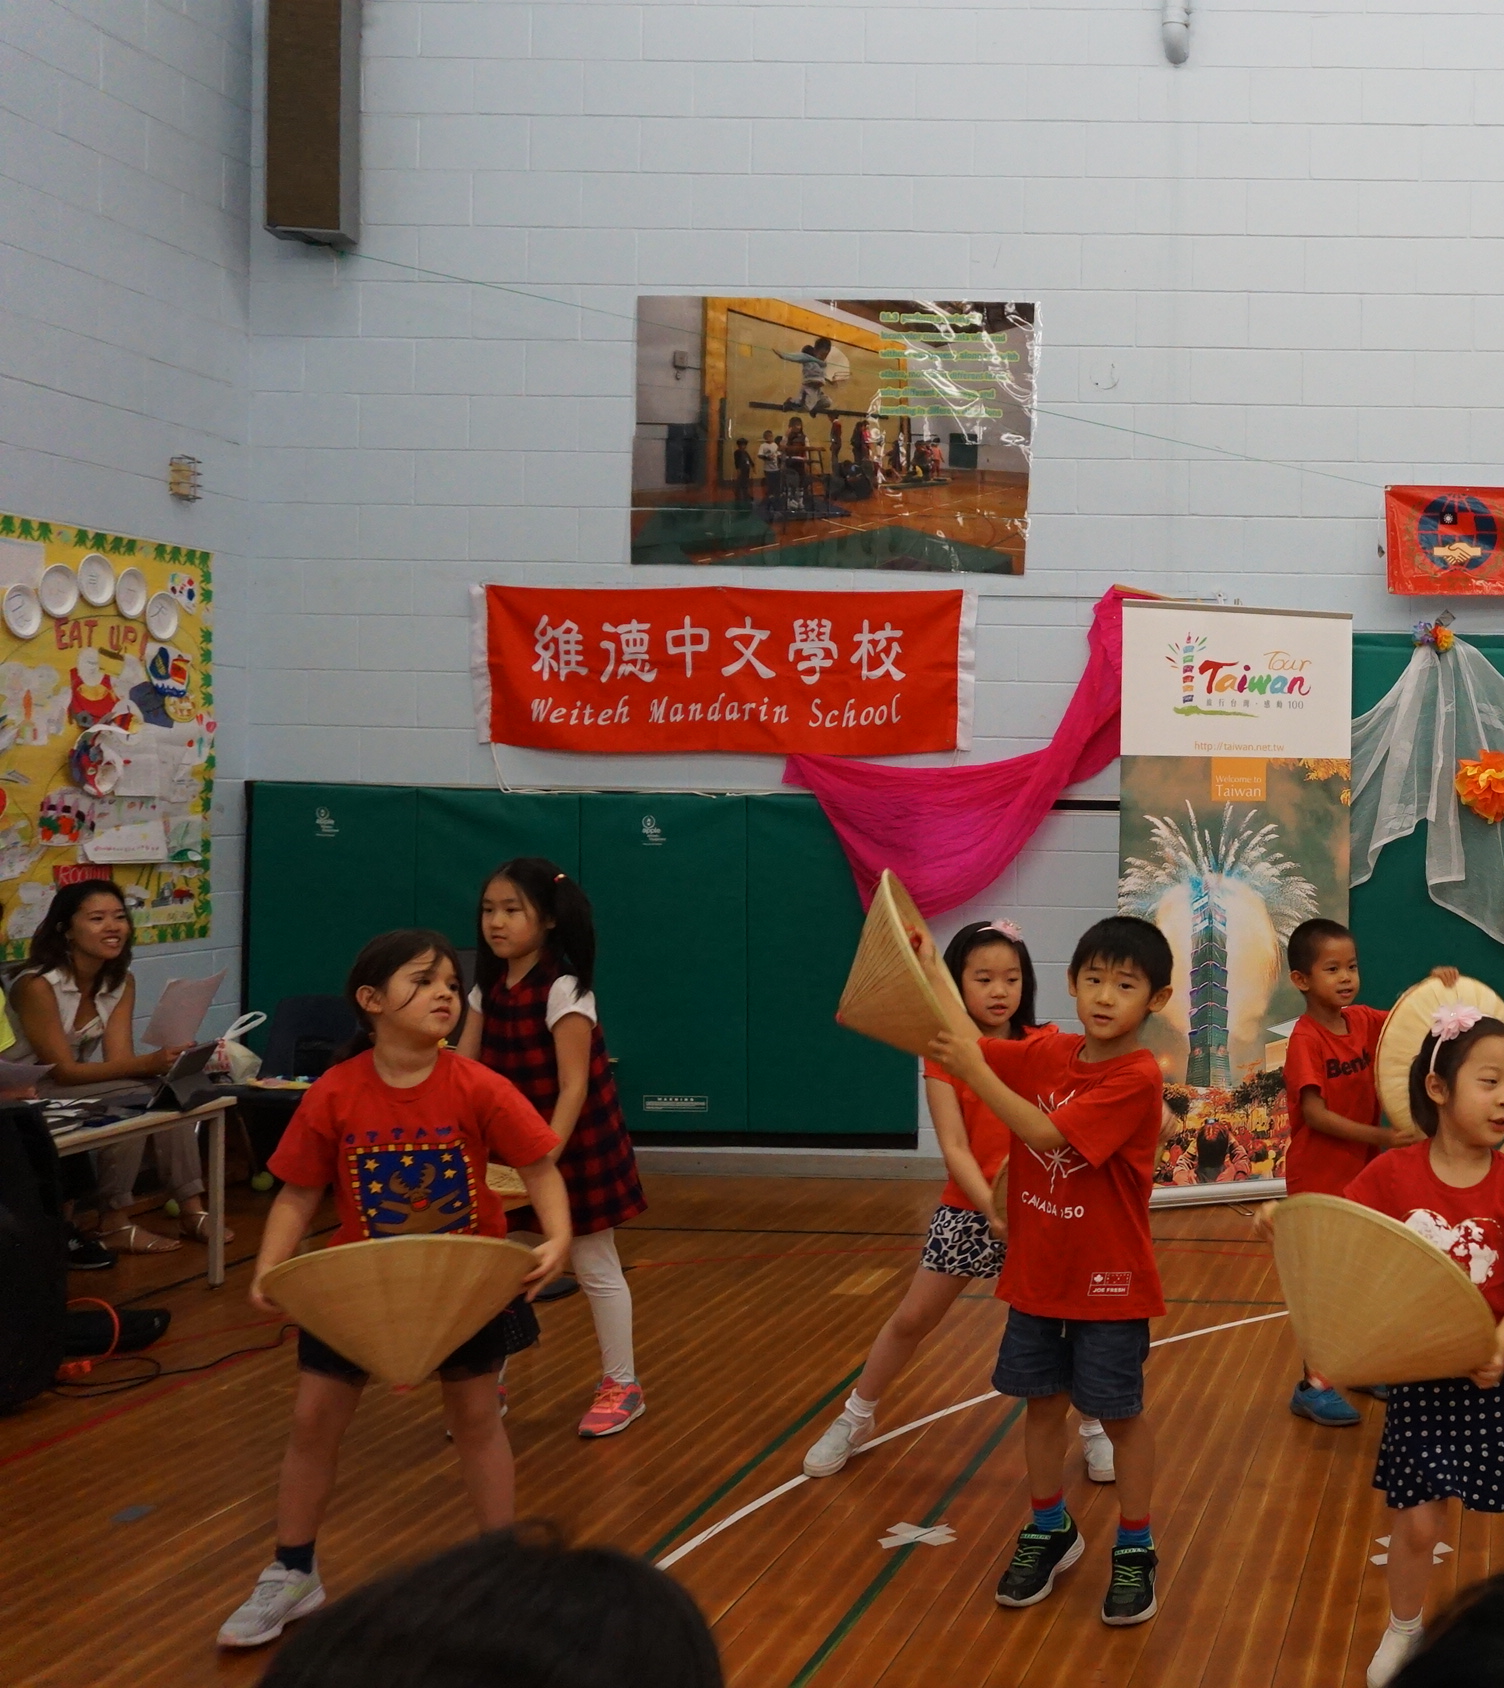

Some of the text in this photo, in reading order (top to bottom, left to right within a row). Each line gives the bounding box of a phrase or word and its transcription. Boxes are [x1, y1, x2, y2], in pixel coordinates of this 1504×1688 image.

[54, 617, 98, 650] EAT
[531, 614, 907, 684] 維德中文學校
[1264, 651, 1312, 672] Tour
[1198, 659, 1312, 696] Taiwan
[531, 693, 902, 728] Weiteh Mandarin School
[1194, 740, 1285, 752] http://taiwan.net.tw
[1215, 774, 1262, 784] Welcome to
[1216, 784, 1262, 798] Taiwan
